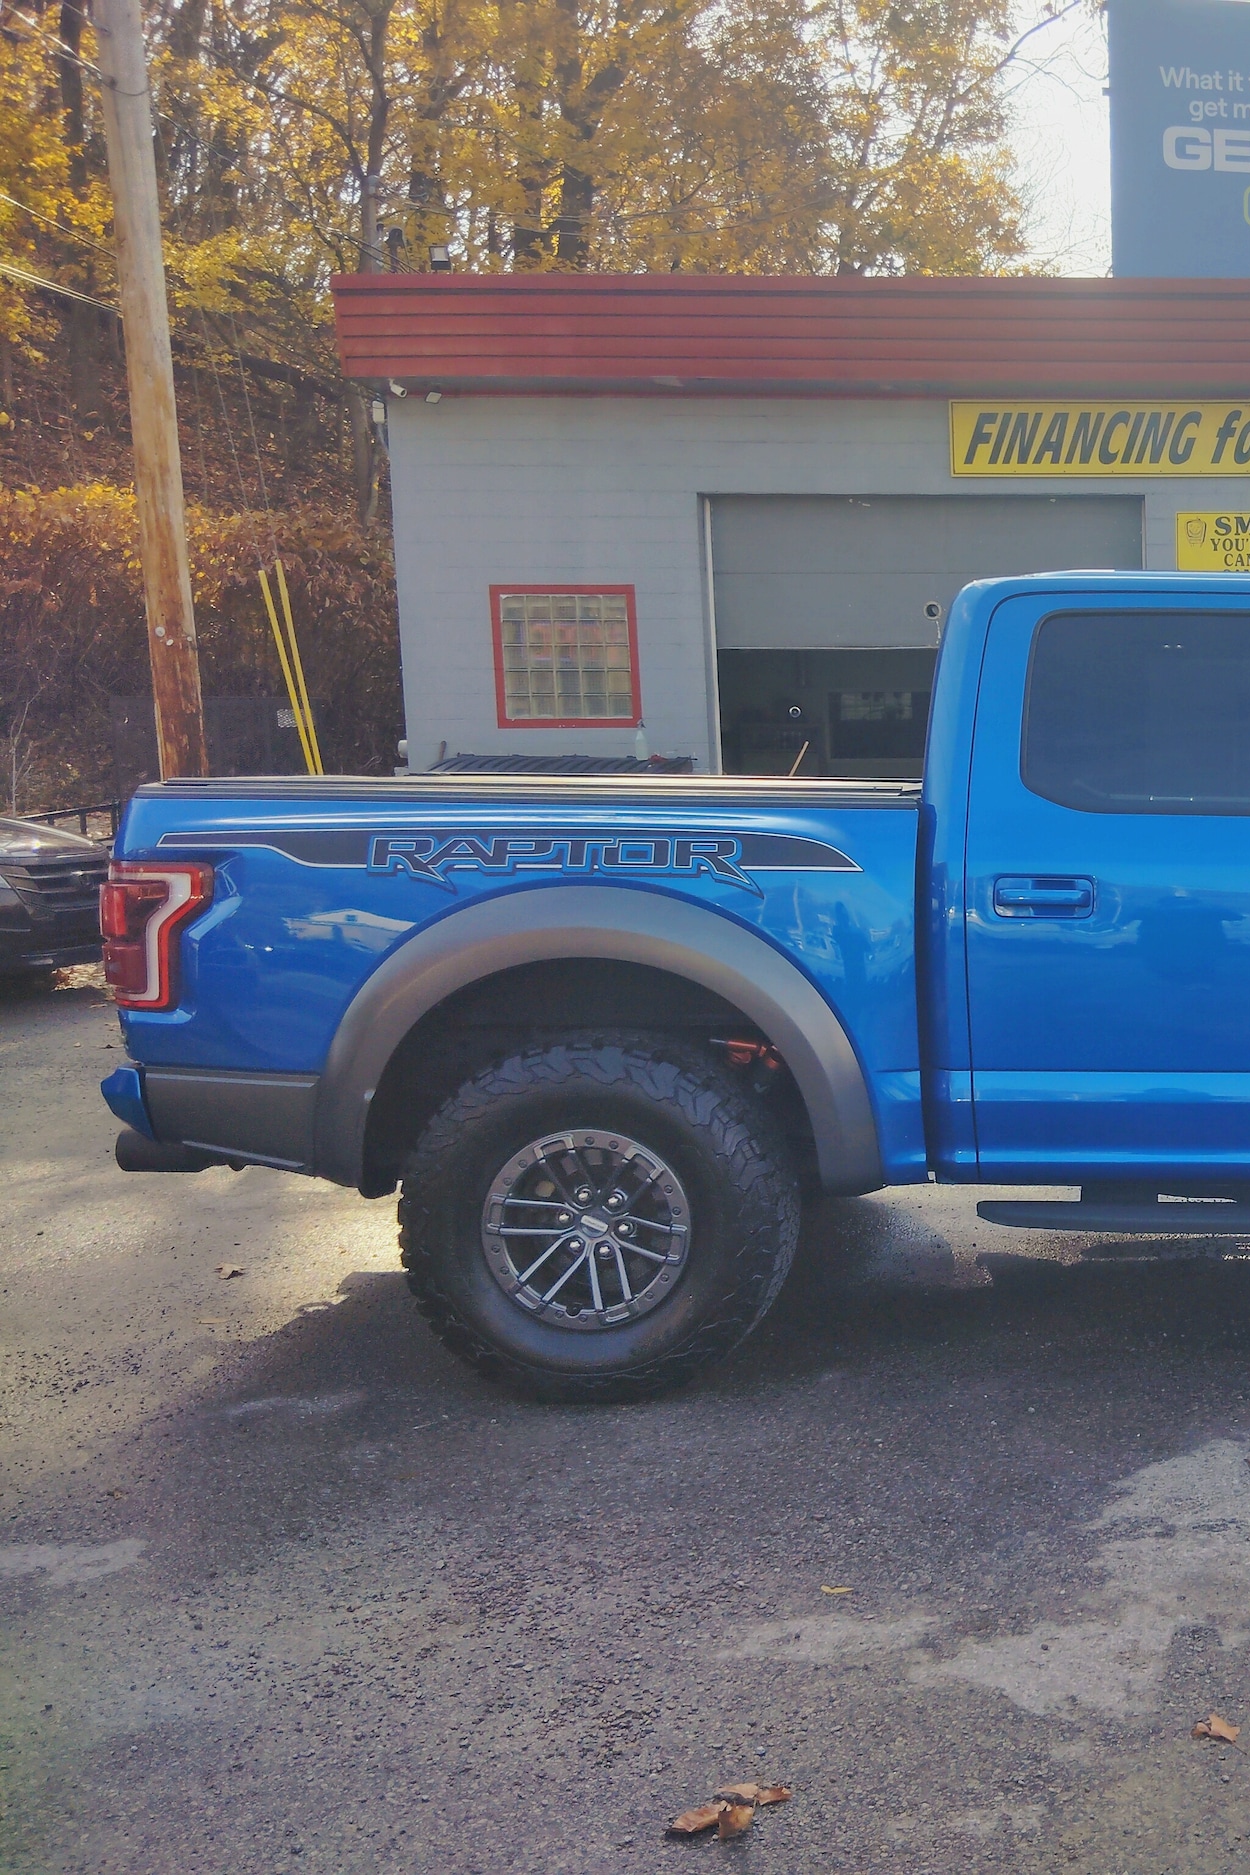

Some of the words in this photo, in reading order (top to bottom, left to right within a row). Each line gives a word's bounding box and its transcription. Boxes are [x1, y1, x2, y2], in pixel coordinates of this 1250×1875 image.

[1159, 66, 1223, 91] What
[1228, 69, 1244, 92] it
[1189, 98, 1228, 122] get
[963, 411, 1202, 465] FINANCING
[368, 834, 765, 899] RAPTOR
